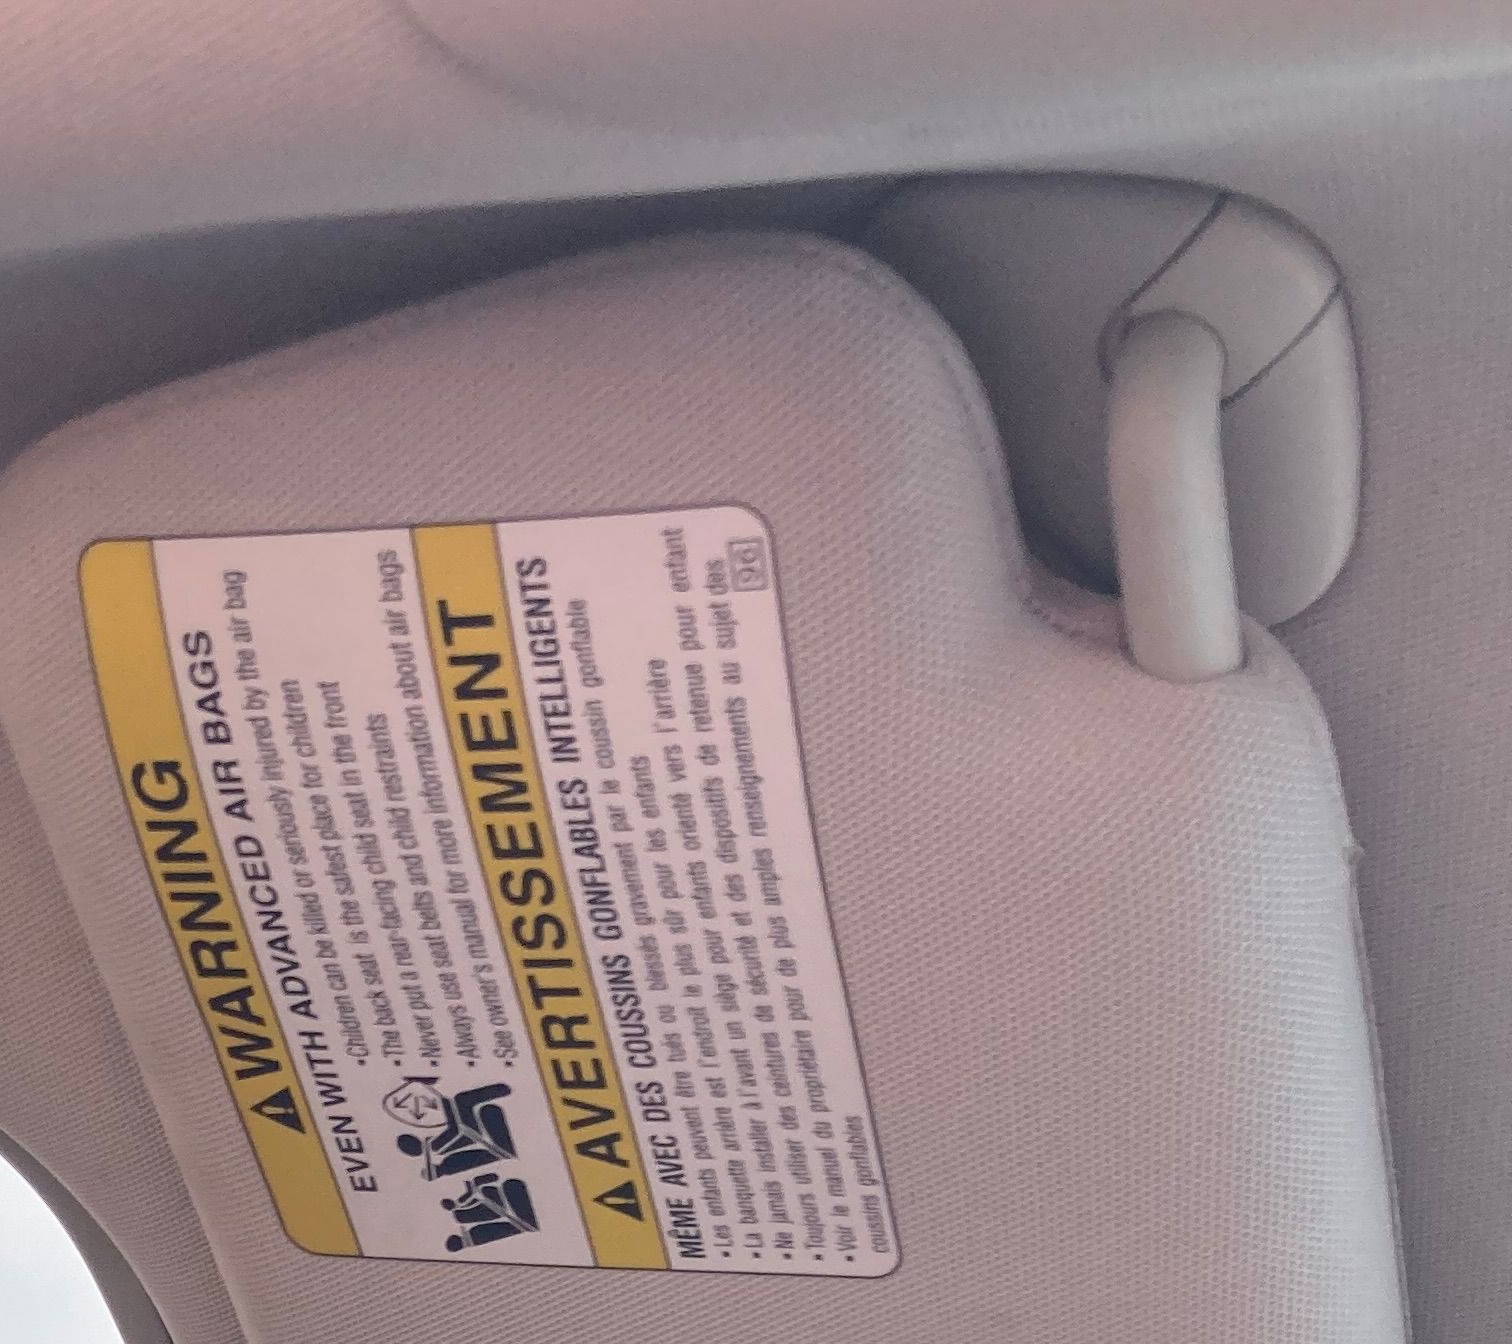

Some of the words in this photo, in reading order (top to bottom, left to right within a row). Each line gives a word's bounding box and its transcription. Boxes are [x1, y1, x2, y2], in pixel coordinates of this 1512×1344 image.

[375, 548, 405, 601] bags
[658, 527, 690, 591] enfant
[703, 559, 728, 595] des
[222, 569, 248, 608] bag
[226, 617, 252, 642] air
[382, 608, 409, 635] air
[564, 598, 605, 686] gonflable
[675, 605, 705, 650] pour
[706, 601, 739, 649] sujet
[233, 648, 260, 680] the
[385, 642, 421, 699] about
[515, 557, 581, 762] INTELLIGENTS
[720, 661, 742, 684] au
[182, 630, 234, 743] BAGS
[241, 686, 269, 710] by
[314, 680, 348, 727] front
[646, 658, 678, 733] l'arrière
[683, 663, 713, 731] retenue
[280, 678, 316, 757] children
[581, 699, 616, 768] coussin
[245, 716, 285, 780] injured
[330, 734, 357, 763] the
[365, 713, 406, 801] restraints
[404, 705, 449, 813] information
[663, 743, 687, 781] vers
[694, 743, 719, 765] de
[722, 696, 767, 835] renseignements
[211, 759, 254, 821] AIR
[300, 762, 324, 788] for
[339, 769, 363, 786] in
[598, 779, 621, 793] le
[628, 755, 661, 818] enfants
[266, 786, 307, 863] seriously
[309, 793, 345, 840] place
[342, 791, 373, 827] seat
[385, 807, 418, 848] child
[607, 804, 636, 831] par
[667, 793, 702, 850] orienté
[701, 776, 739, 862] dispositifs
[352, 833, 387, 873] child
[431, 818, 462, 864] more
[556, 778, 624, 940] GONFLABLES
[645, 829, 668, 851] les
[292, 870, 315, 887] or
[319, 845, 356, 895] safest
[397, 854, 429, 885] and
[436, 596, 630, 1167] AVERTISSEMENT
[445, 870, 470, 893] for
[611, 841, 658, 925] gravement
[654, 864, 685, 898] pour
[684, 860, 717, 918] enfants
[723, 874, 747, 901] des
[751, 847, 783, 905] amples
[131, 759, 282, 1079] WARNING
[232, 834, 318, 1018] ADVANCED
[294, 892, 330, 934] killed
[338, 899, 365, 924] the
[372, 880, 415, 965] rear-facing
[411, 891, 442, 929] belts
[448, 898, 488, 958] manual
[662, 910, 687, 933] sûr
[727, 911, 752, 925] et
[312, 940, 337, 957] be
[347, 930, 371, 943] is
[422, 935, 453, 967] seat
[703, 929, 734, 963] pour
[766, 916, 797, 948] plus
[322, 963, 349, 990] can
[352, 954, 384, 984] seat
[400, 971, 419, 979] a
[636, 936, 669, 989] blessés
[673, 944, 704, 975] plus
[732, 935, 768, 994] sécurité
[774, 958, 798, 976] de
[364, 990, 396, 1024] back
[398, 984, 433, 1009] put
[437, 973, 462, 999] use
[469, 964, 509, 1025] owner's
[681, 985, 703, 996] le
[713, 974, 741, 1011] siège
[783, 987, 813, 1020] pour
[334, 995, 370, 1057] Children
[446, 1004, 480, 1058] Always
[599, 954, 657, 1068] COUSSINS
[656, 1005, 677, 1022] ou
[726, 1022, 746, 1038] un
[751, 1005, 774, 1021] de
[379, 1030, 405, 1057] The
[412, 1015, 442, 1057] Never
[492, 1030, 518, 1058] See
[660, 1032, 687, 1060] tués
[684, 1006, 720, 1066] l'endroit
[297, 1031, 347, 1106] WITH
[672, 1071, 696, 1096] être
[727, 1048, 759, 1096] l'avant
[760, 1031, 792, 1096] ceintures
[791, 1030, 833, 1112] propriétaire
[633, 1081, 671, 1121] DES
[701, 1077, 727, 1096] est
[677, 1106, 717, 1159] peuvent
[712, 1106, 741, 1150] arrière
[776, 1105, 800, 1129] des
[810, 1121, 833, 1138] du
[327, 1115, 378, 1191] EVEN
[647, 1134, 687, 1186] AVEC
[747, 1119, 777, 1171] installer
[785, 1140, 812, 1184] utiliser
[842, 1116, 881, 1186] gonflables
[695, 1168, 726, 1215] enfants
[724, 1159, 758, 1223] banquette
[814, 1147, 845, 1196] manuel
[760, 1180, 794, 1223] jamais
[797, 1192, 827, 1249] Toujours
[827, 1205, 850, 1215] le
[664, 1197, 705, 1258] MÊME
[711, 1224, 734, 1247] Les
[741, 1233, 764, 1247] La
[771, 1231, 794, 1248] Ne
[832, 1225, 858, 1251] Voir
[858, 1194, 889, 1252] coussins
